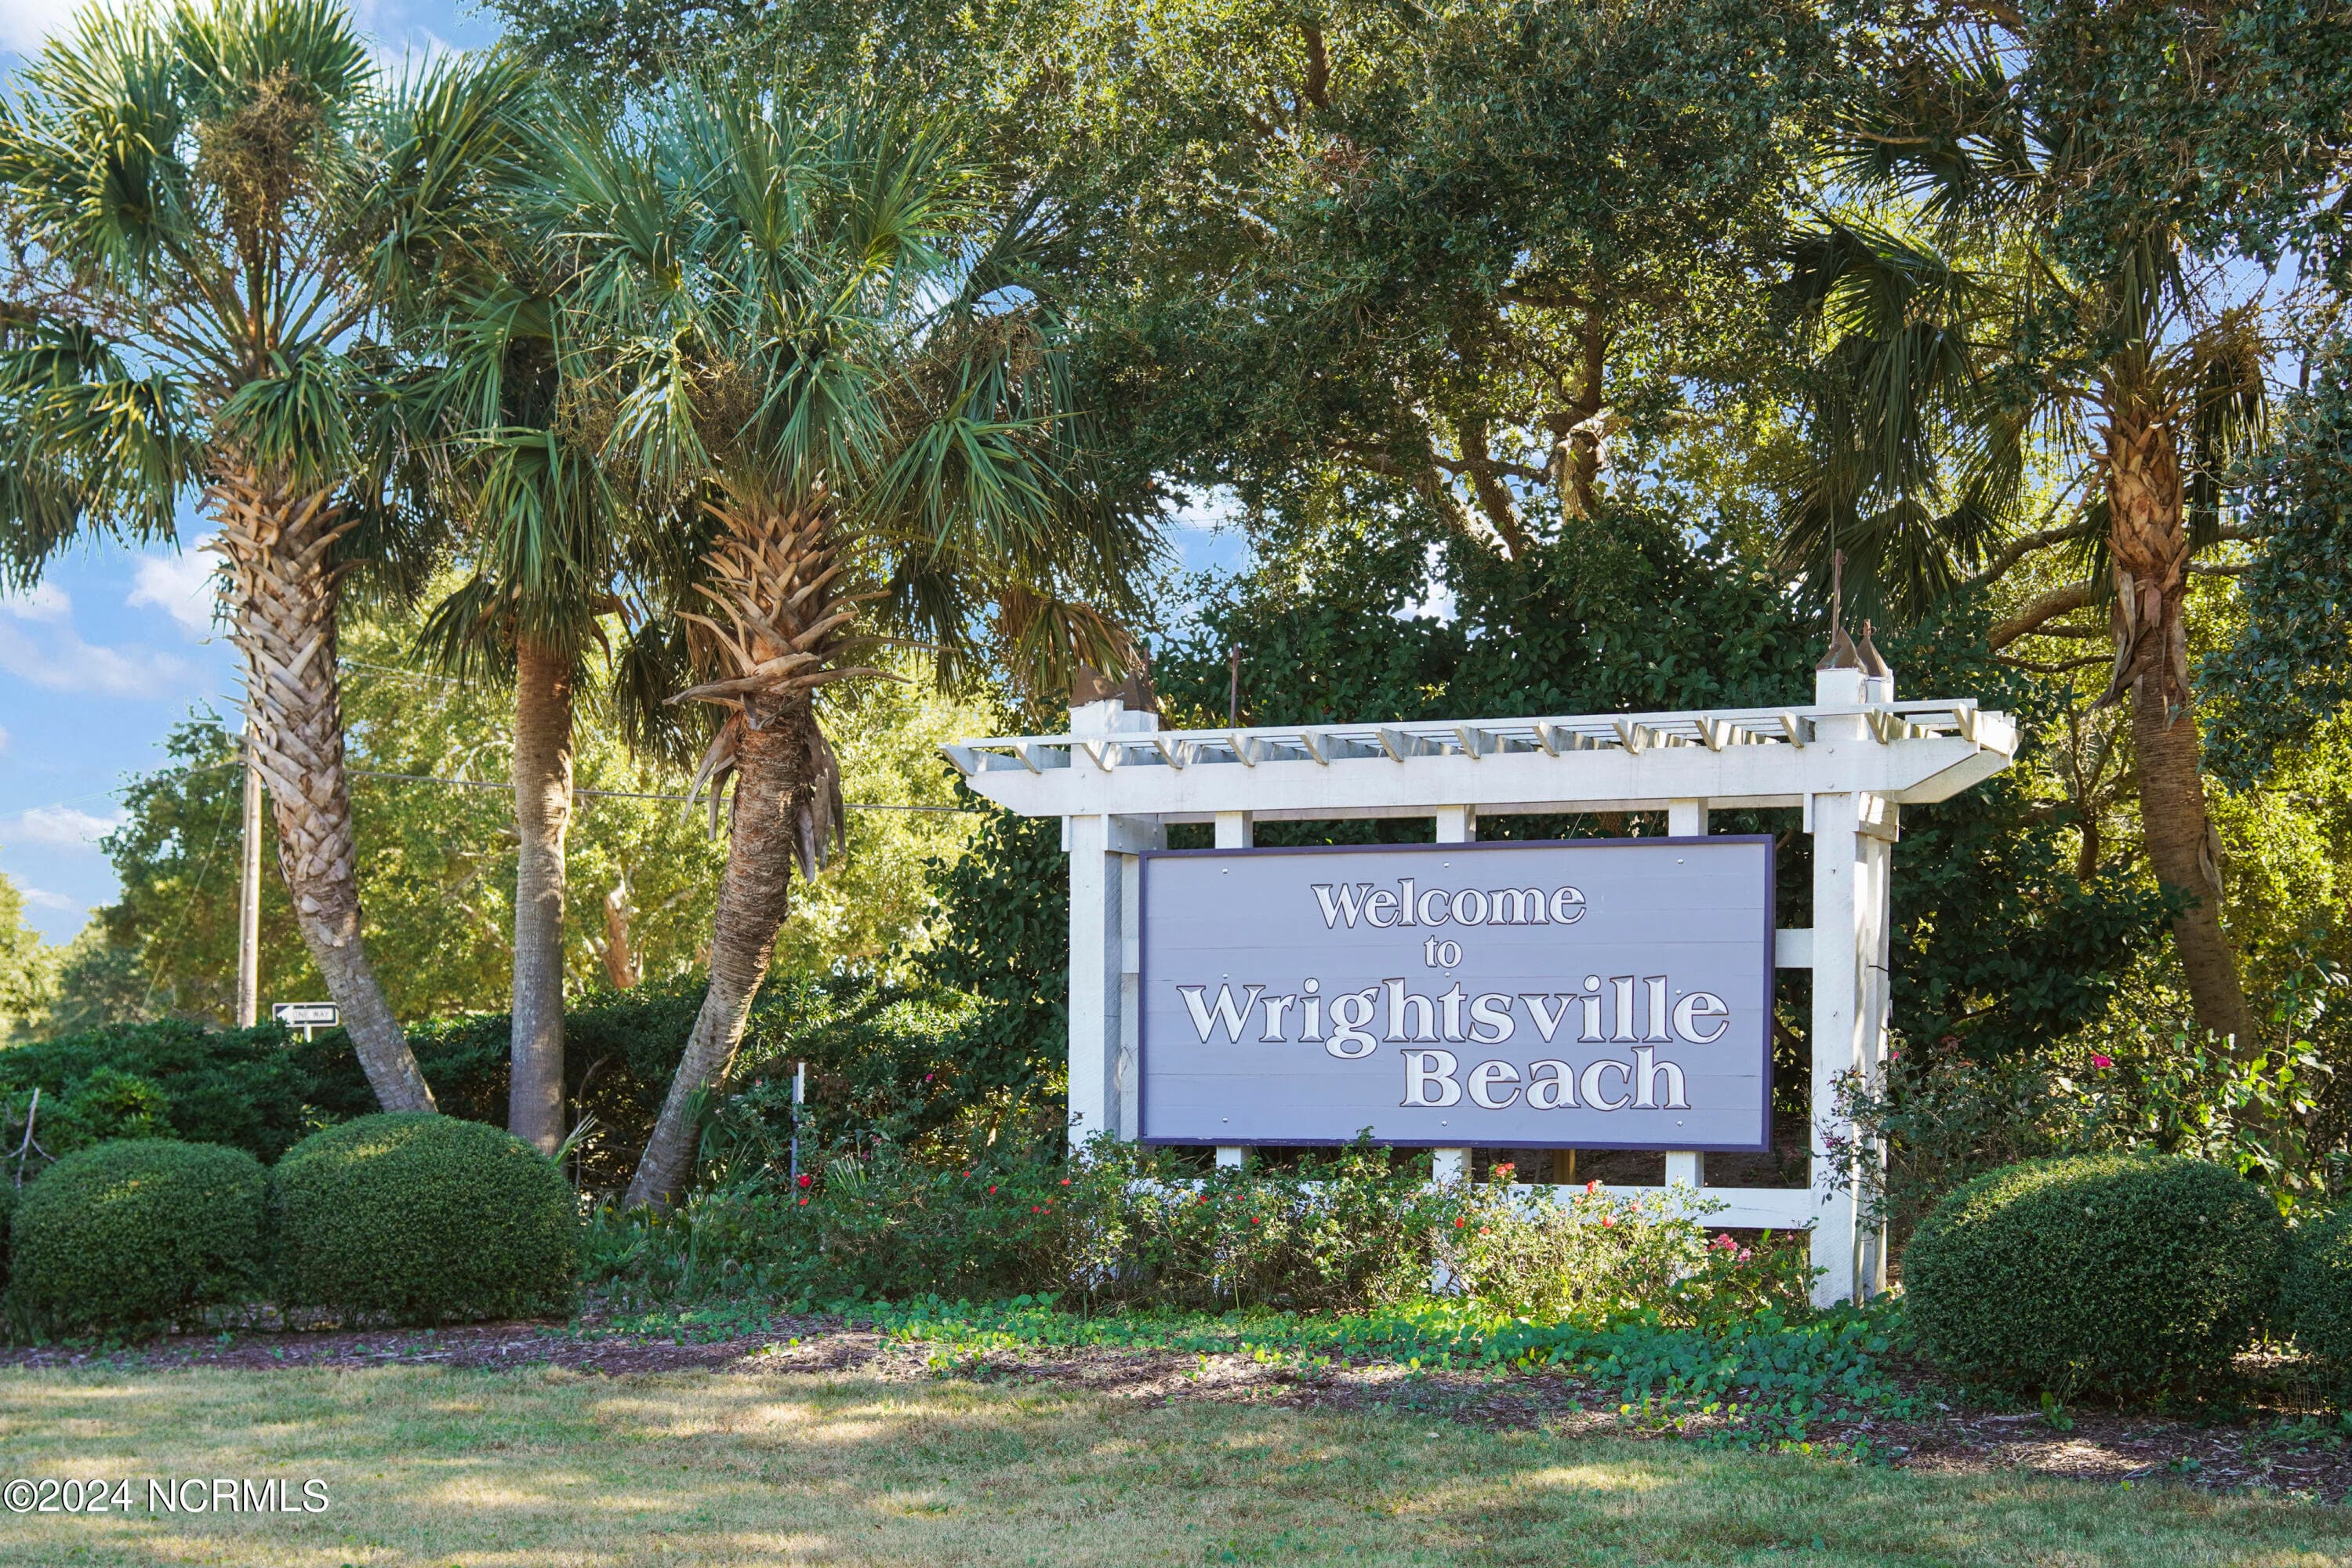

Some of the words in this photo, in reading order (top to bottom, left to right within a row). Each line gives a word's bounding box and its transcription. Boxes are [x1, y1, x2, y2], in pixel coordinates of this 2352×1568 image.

[1311, 877, 1587, 929] Welcome
[1424, 935, 1462, 969] to
[1176, 975, 1730, 1059] Wrightsville
[1399, 1046, 1692, 1111] Beach
